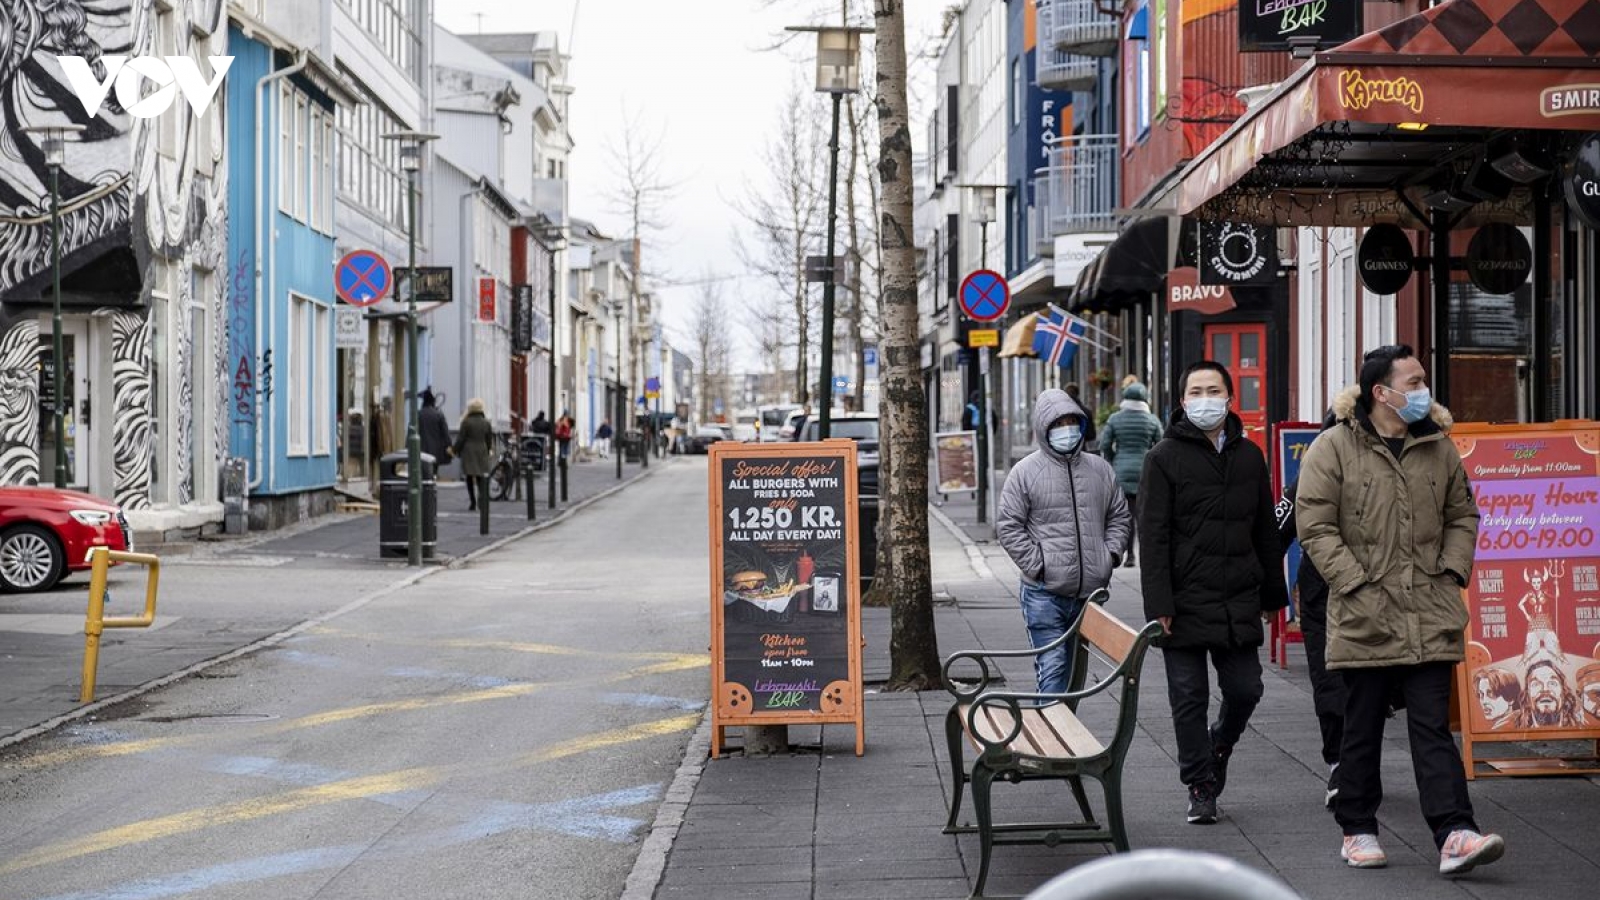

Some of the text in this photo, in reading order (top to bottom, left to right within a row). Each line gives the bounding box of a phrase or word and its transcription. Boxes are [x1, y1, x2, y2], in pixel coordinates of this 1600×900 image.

[1277, 0, 1327, 34] BAR
[1551, 89, 1600, 110] SMIR
[1211, 256, 1266, 281] CINTAMANI
[1364, 258, 1409, 271] GUINNESS
[732, 460, 836, 480] Special offer!
[1474, 465, 1496, 476] Open
[1498, 464, 1520, 477] daily
[1522, 463, 1543, 475] from
[729, 477, 838, 490] ALL BURGERS WITH
[754, 489, 815, 499] FRIES & SODA
[1544, 482, 1599, 507] Hour
[768, 496, 798, 511] only
[729, 506, 842, 530] 1.250 KR.
[1483, 512, 1583, 531] Every day between
[729, 529, 841, 541] ALL DAY EVERY DAY!
[760, 634, 806, 648] Kitchen
[764, 647, 809, 659] open from
[761, 658, 782, 667] 11AM
[790, 658, 814, 667] 10PM
[765, 691, 808, 708] BAR
